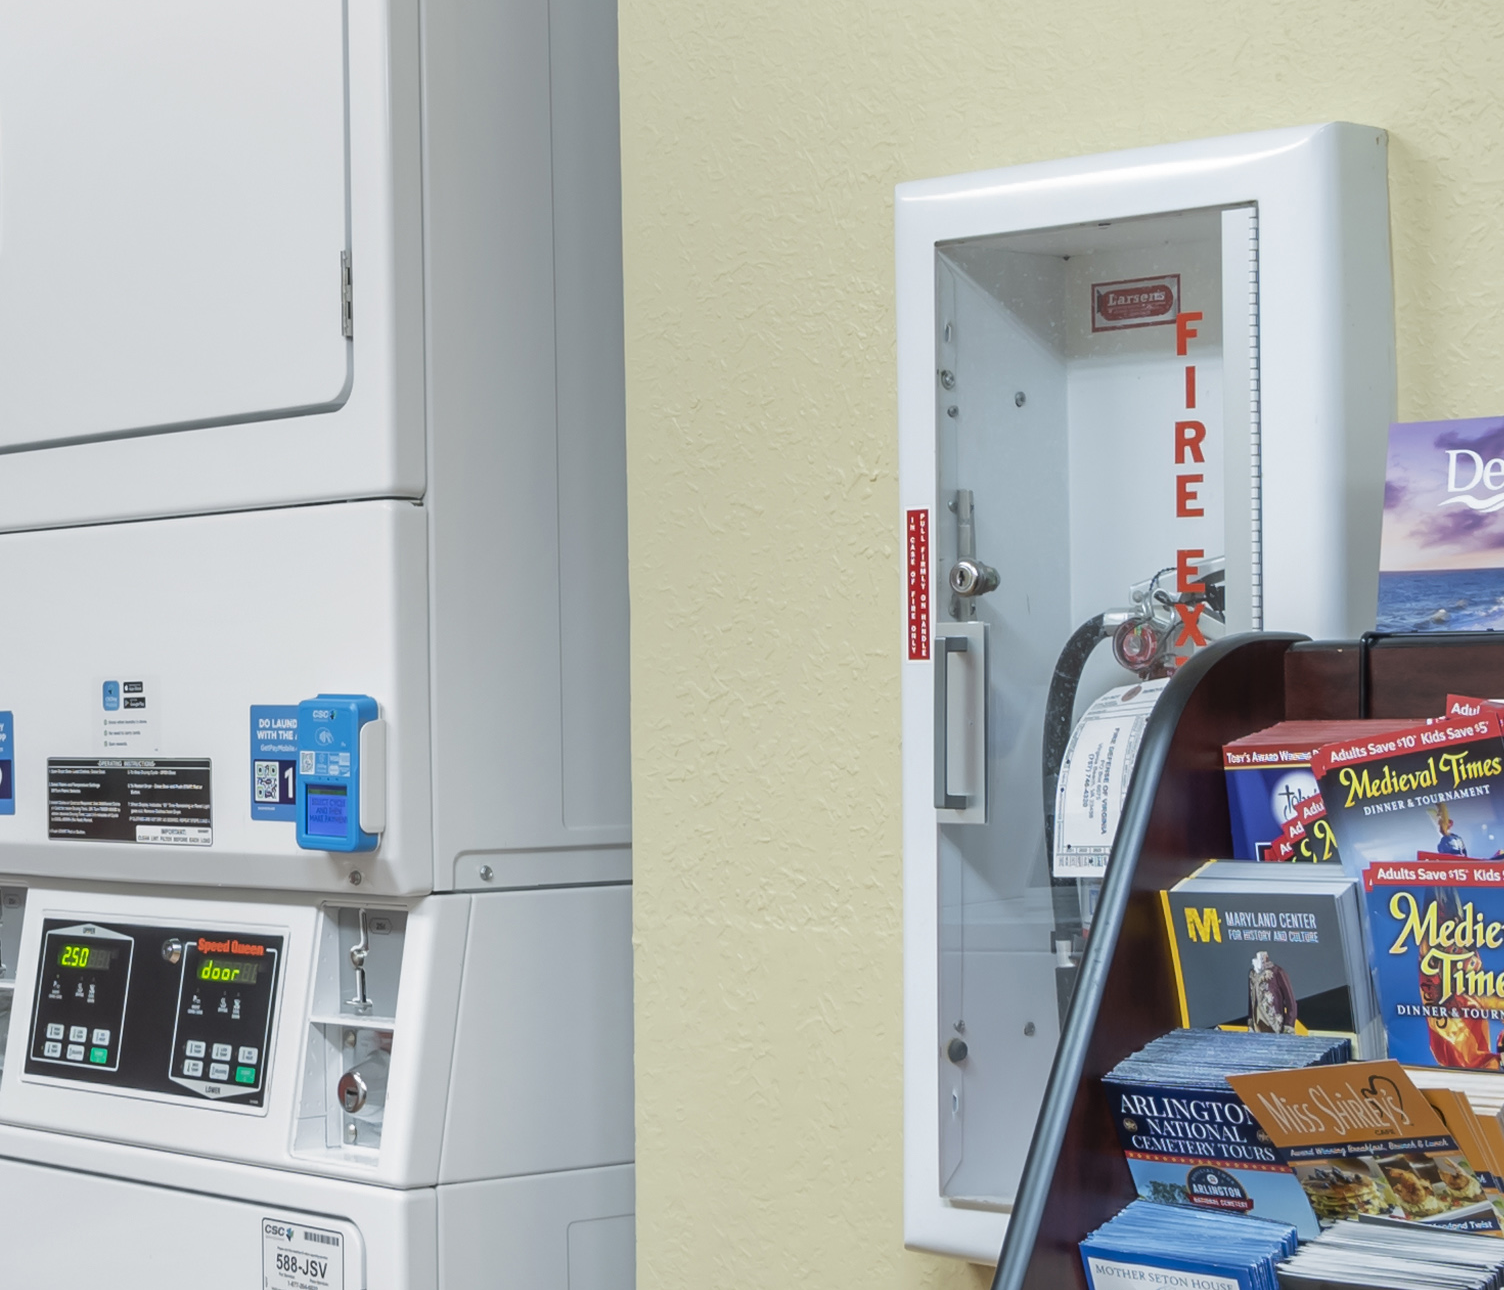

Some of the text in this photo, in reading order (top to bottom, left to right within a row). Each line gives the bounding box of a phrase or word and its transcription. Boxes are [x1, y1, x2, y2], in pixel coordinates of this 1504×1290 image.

[1174, 311, 1207, 518] FIRE
[910, 517, 915, 531] IN
[910, 571, 915, 585] OF
[921, 595, 926, 609] ON
[1377, 867, 1416, 881] Adults
[1418, 869, 1446, 881] Save
[1448, 869, 1466, 881] $15
[1474, 869, 1496, 881] Kids
[197, 938, 264, 955] Speed Queen
[201, 961, 240, 981] door
[1397, 1004, 1448, 1017] DINNER
[1451, 1009, 1459, 1017] &
[265, 1225, 284, 1236] CSC
[277, 1254, 327, 1279] 588-JSV
